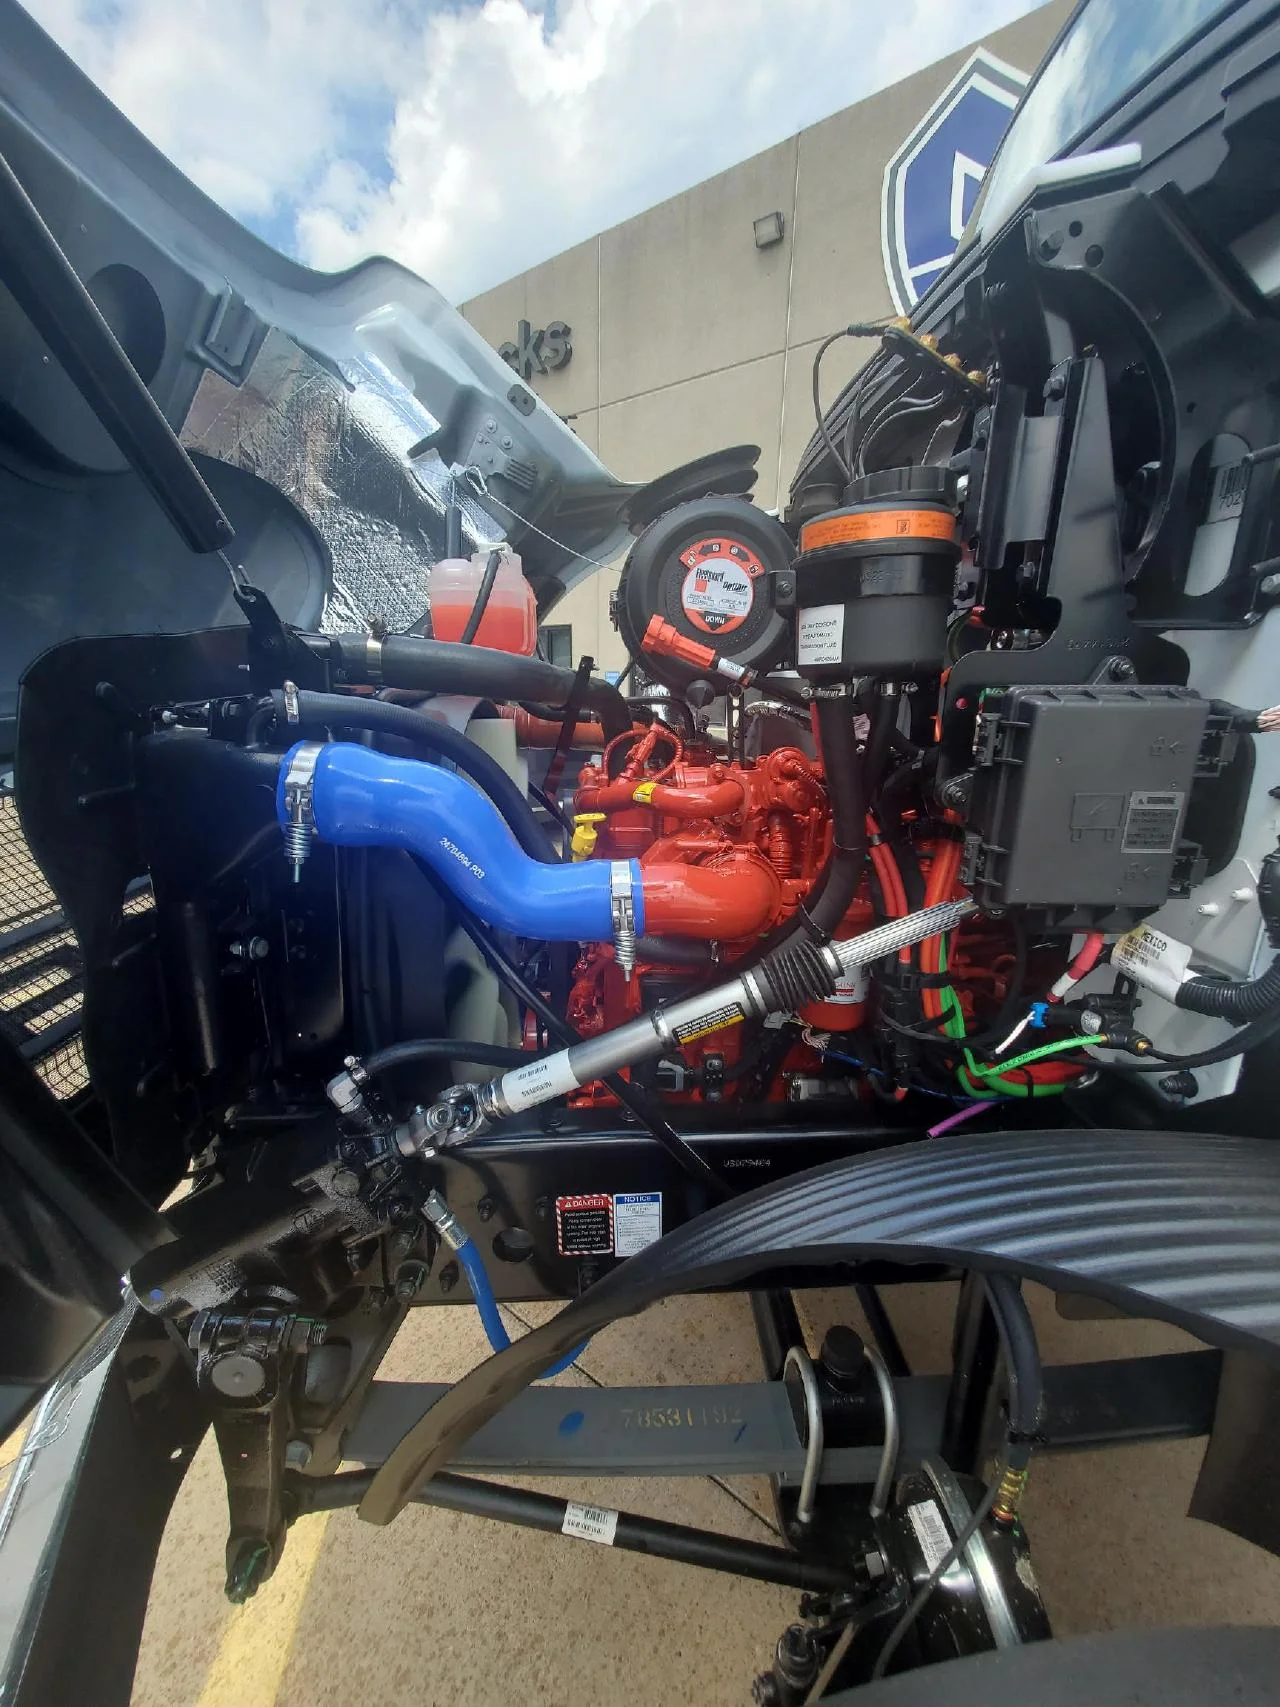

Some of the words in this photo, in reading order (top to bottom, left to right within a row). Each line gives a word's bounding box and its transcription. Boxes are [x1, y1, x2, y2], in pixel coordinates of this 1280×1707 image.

[705, 615, 726, 625] DOWN
[1143, 930, 1168, 952] MEXICO
[572, 1199, 604, 1208] DANGER
[624, 1195, 652, 1203] NOTICE
